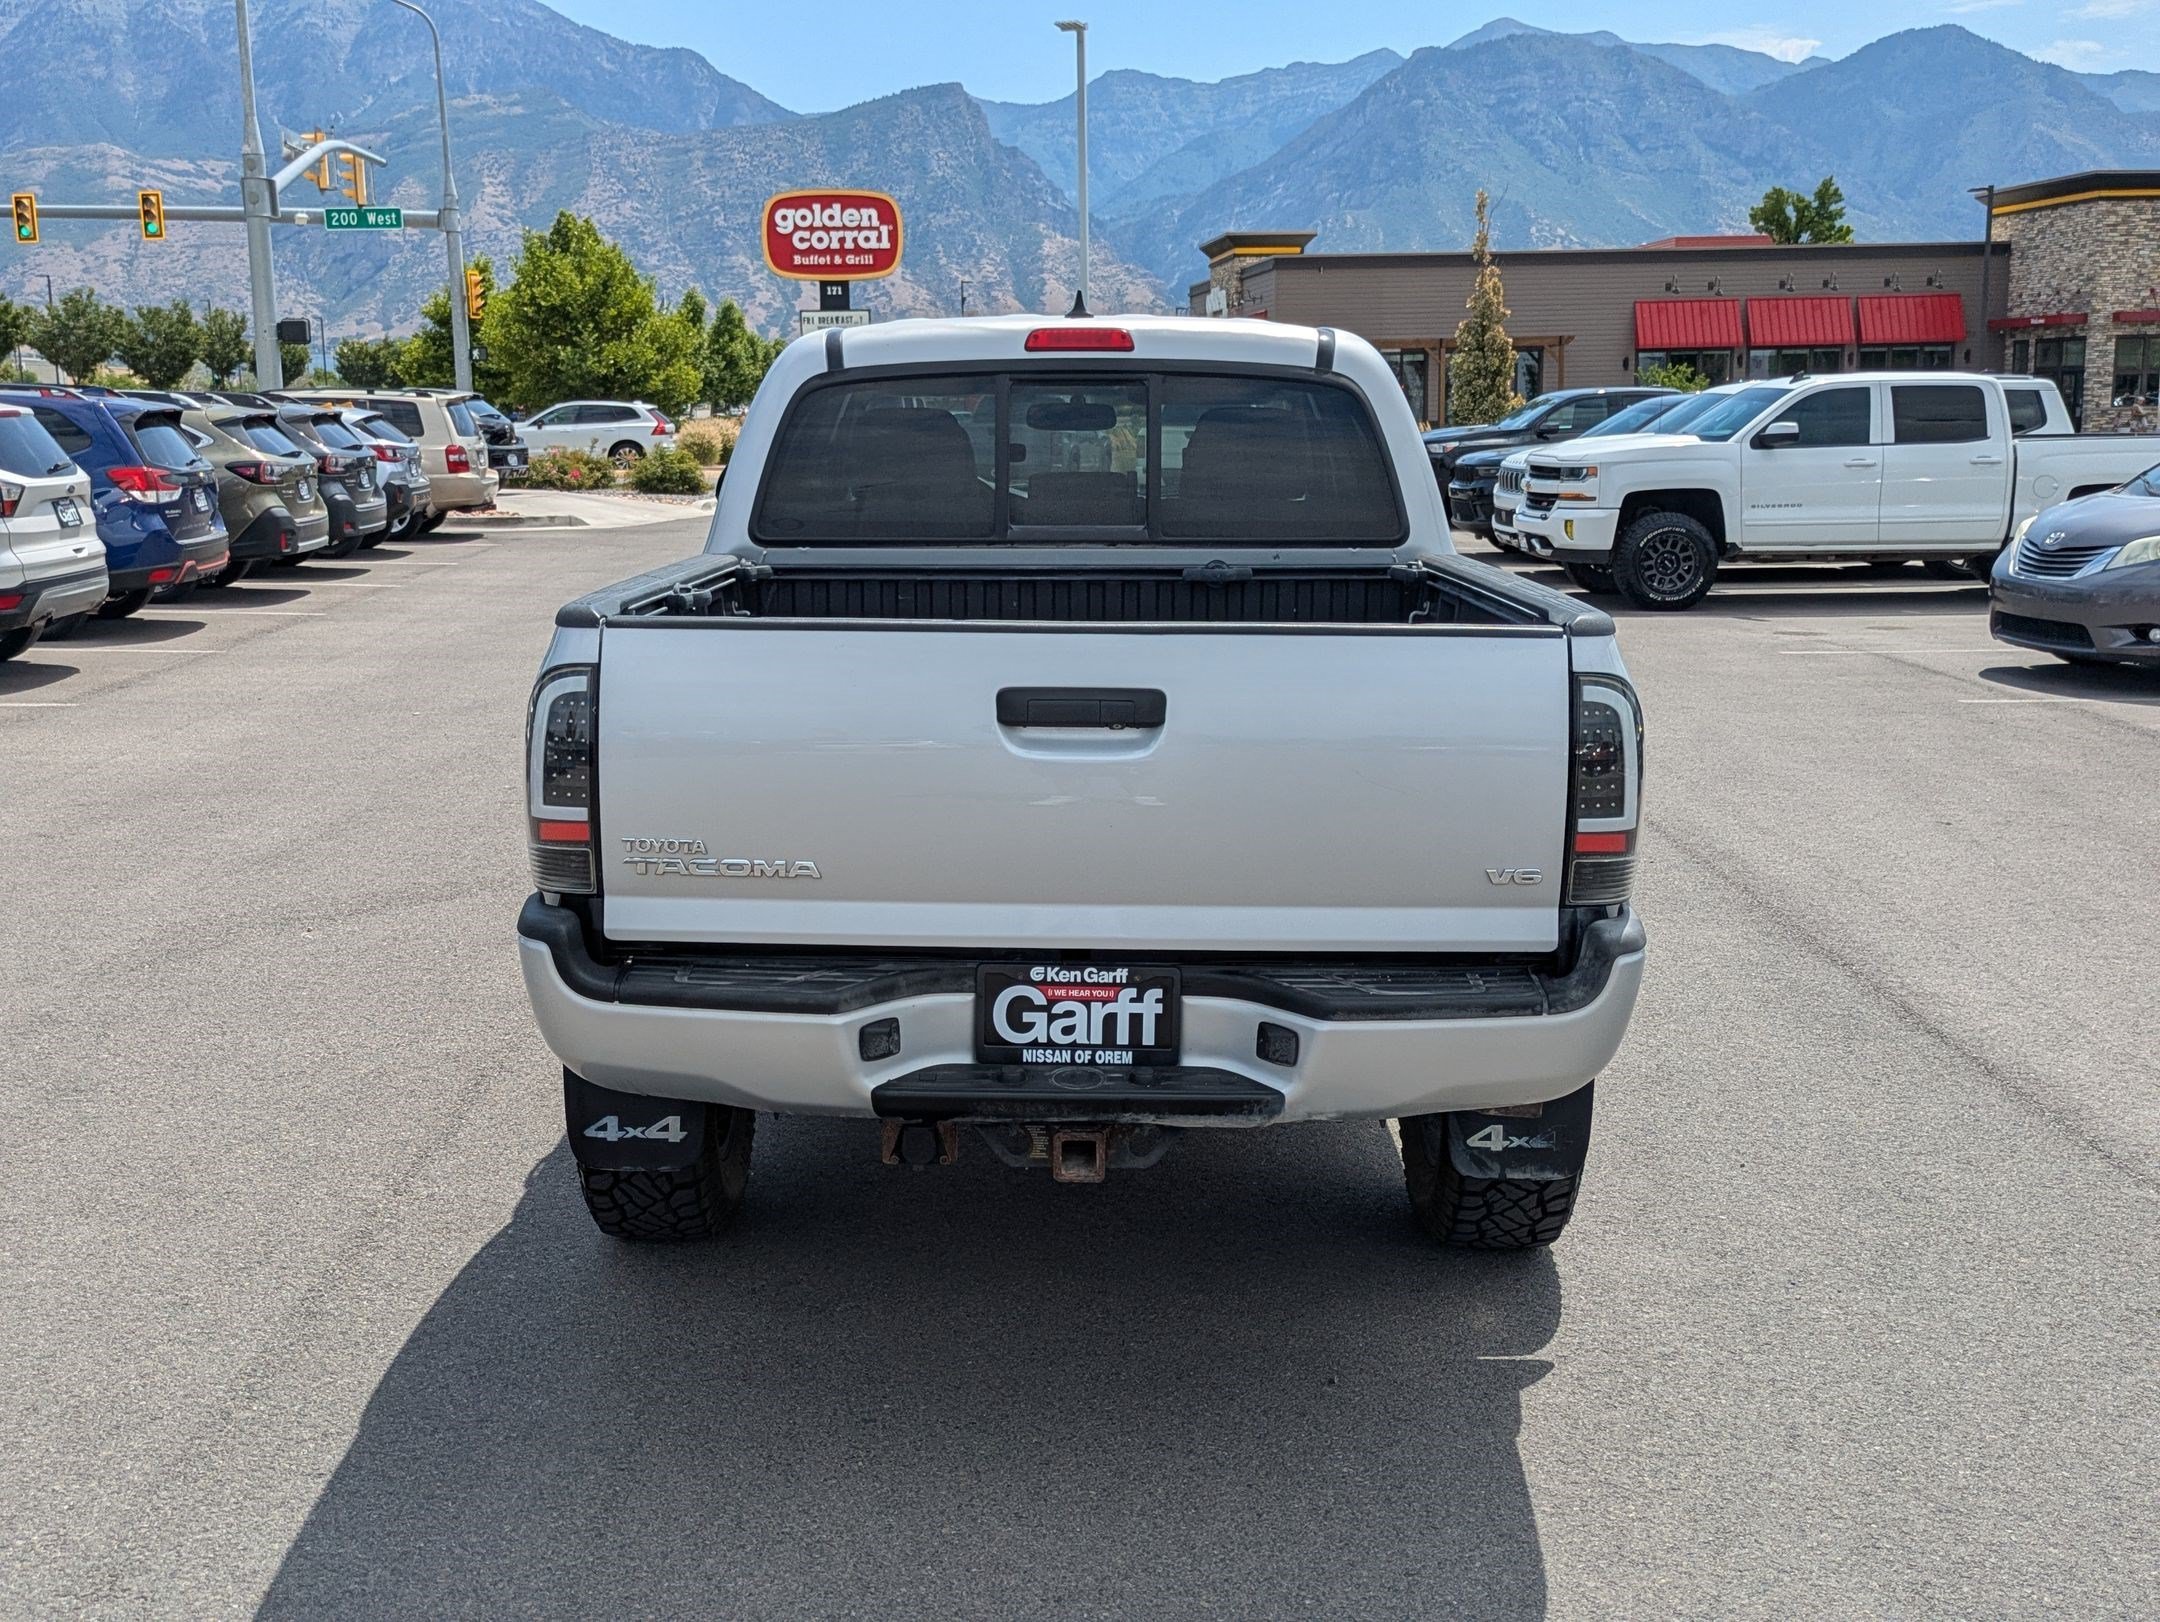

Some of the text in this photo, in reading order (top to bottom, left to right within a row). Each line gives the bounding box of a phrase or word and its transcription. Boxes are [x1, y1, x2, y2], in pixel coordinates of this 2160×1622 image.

[331, 212, 397, 226] 200 West
[774, 203, 880, 234] golden
[792, 225, 890, 250] corral
[793, 254, 873, 265] Buffet & Grill
[621, 837, 708, 855] TOYOTA
[623, 857, 823, 879] TACOMA
[1485, 868, 1543, 886] V6
[1046, 966, 1129, 984] Ken Garff
[1053, 988, 1109, 998] WE HEAR YOU
[992, 984, 1164, 1046] Garff
[1022, 1049, 1133, 1065] NISSAN OF OREM
[583, 1115, 688, 1143] 4x4
